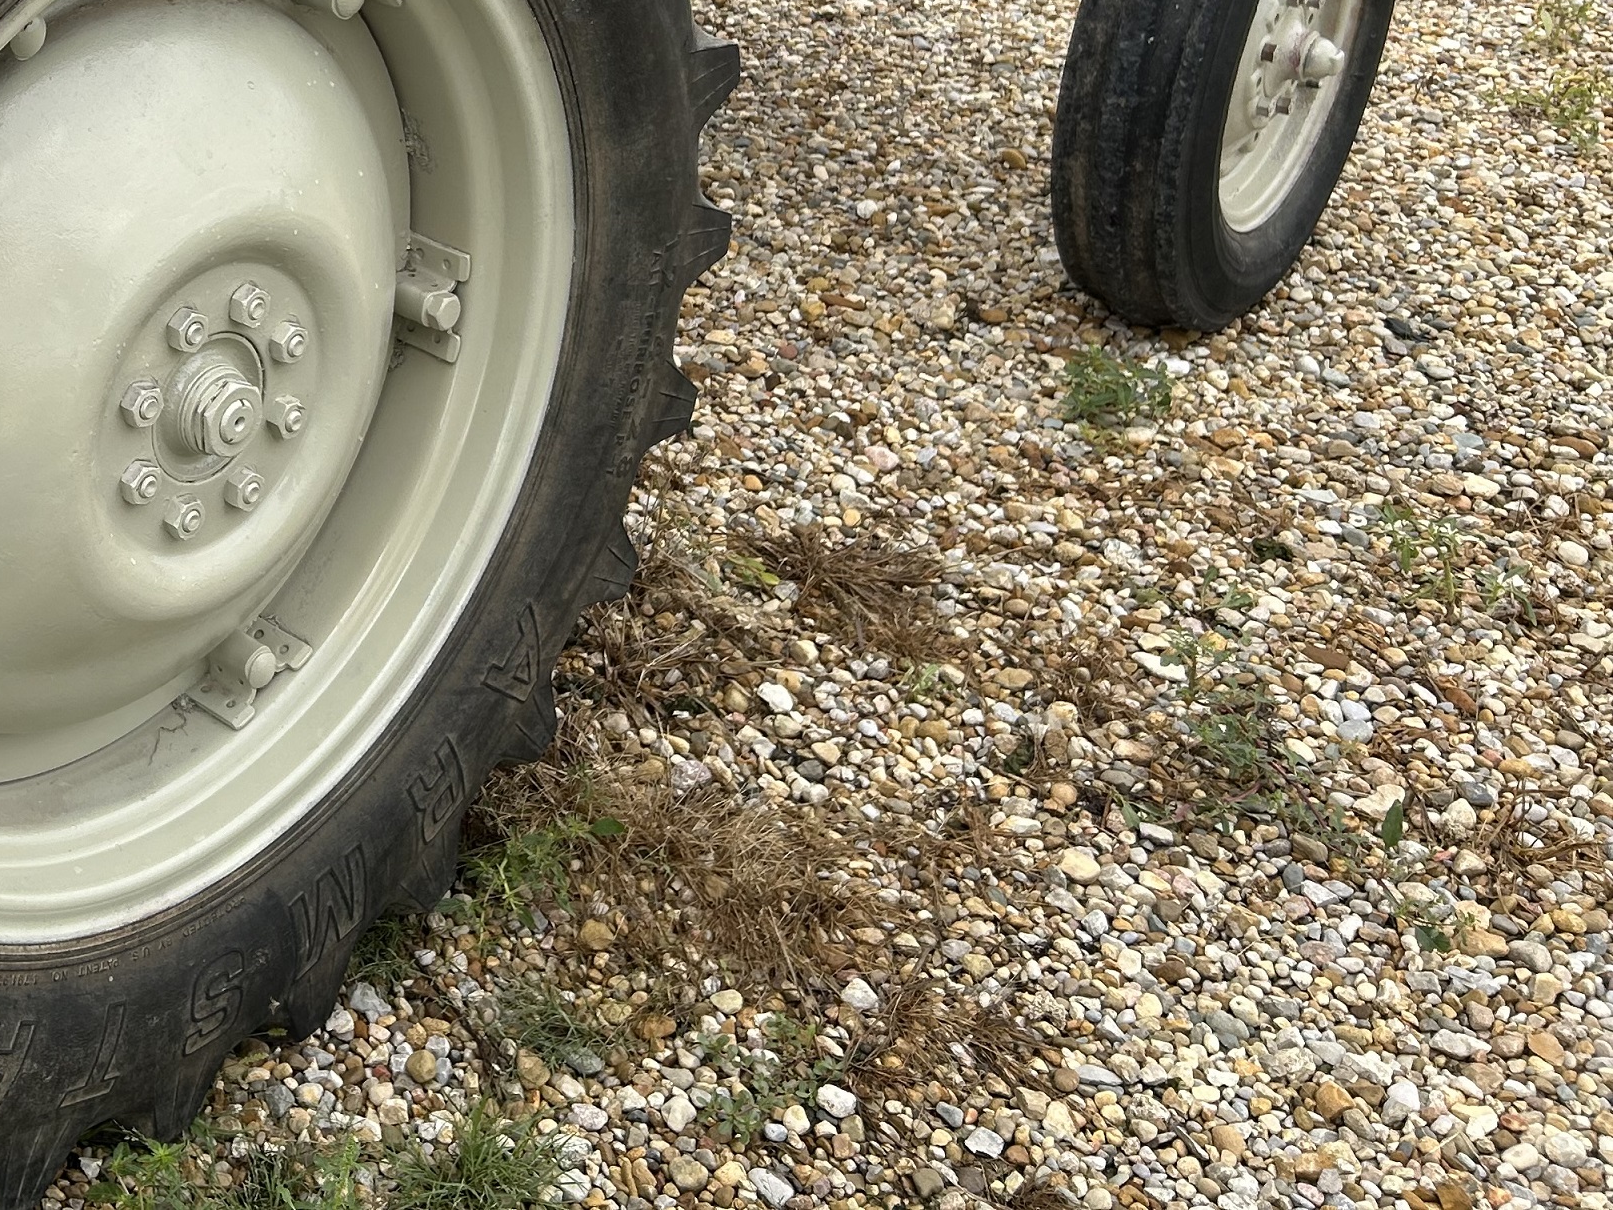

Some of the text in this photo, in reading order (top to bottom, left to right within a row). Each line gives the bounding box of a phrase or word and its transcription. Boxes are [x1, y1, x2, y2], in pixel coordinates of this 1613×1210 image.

[182, 895, 247, 939] PROTECTED
[157, 938, 173, 952] BY
[76, 957, 121, 979] PATENT
